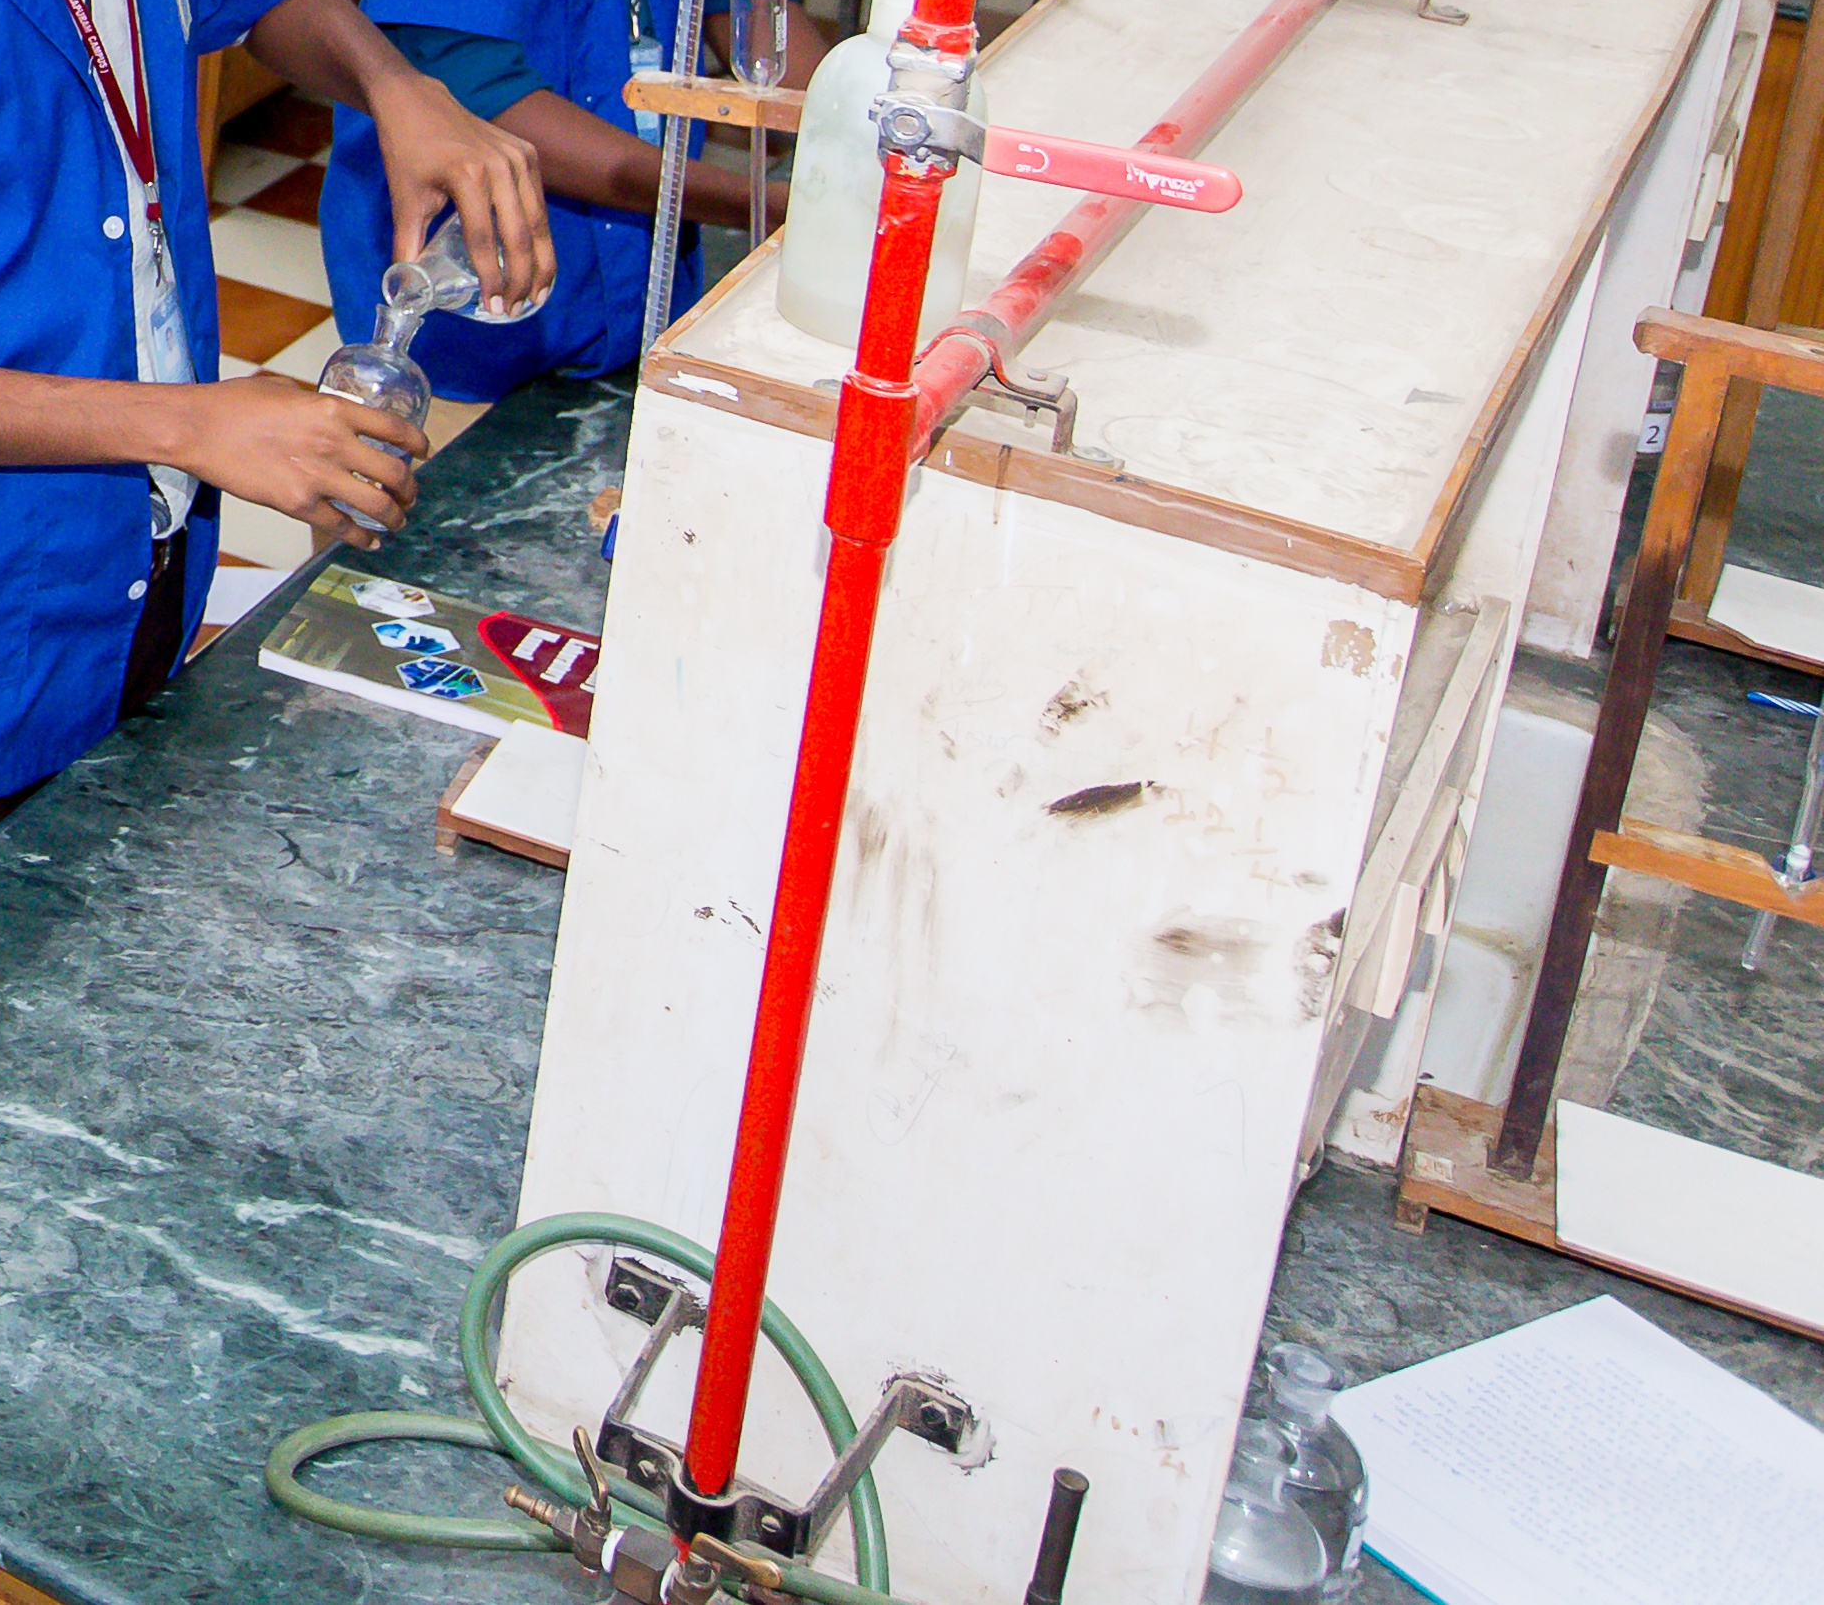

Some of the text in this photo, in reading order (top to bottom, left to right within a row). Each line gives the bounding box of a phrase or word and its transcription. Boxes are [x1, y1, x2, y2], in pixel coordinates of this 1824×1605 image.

[1018, 143, 1032, 152] ON
[1015, 164, 1032, 173] OFF
[1646, 425, 1660, 444] 2
